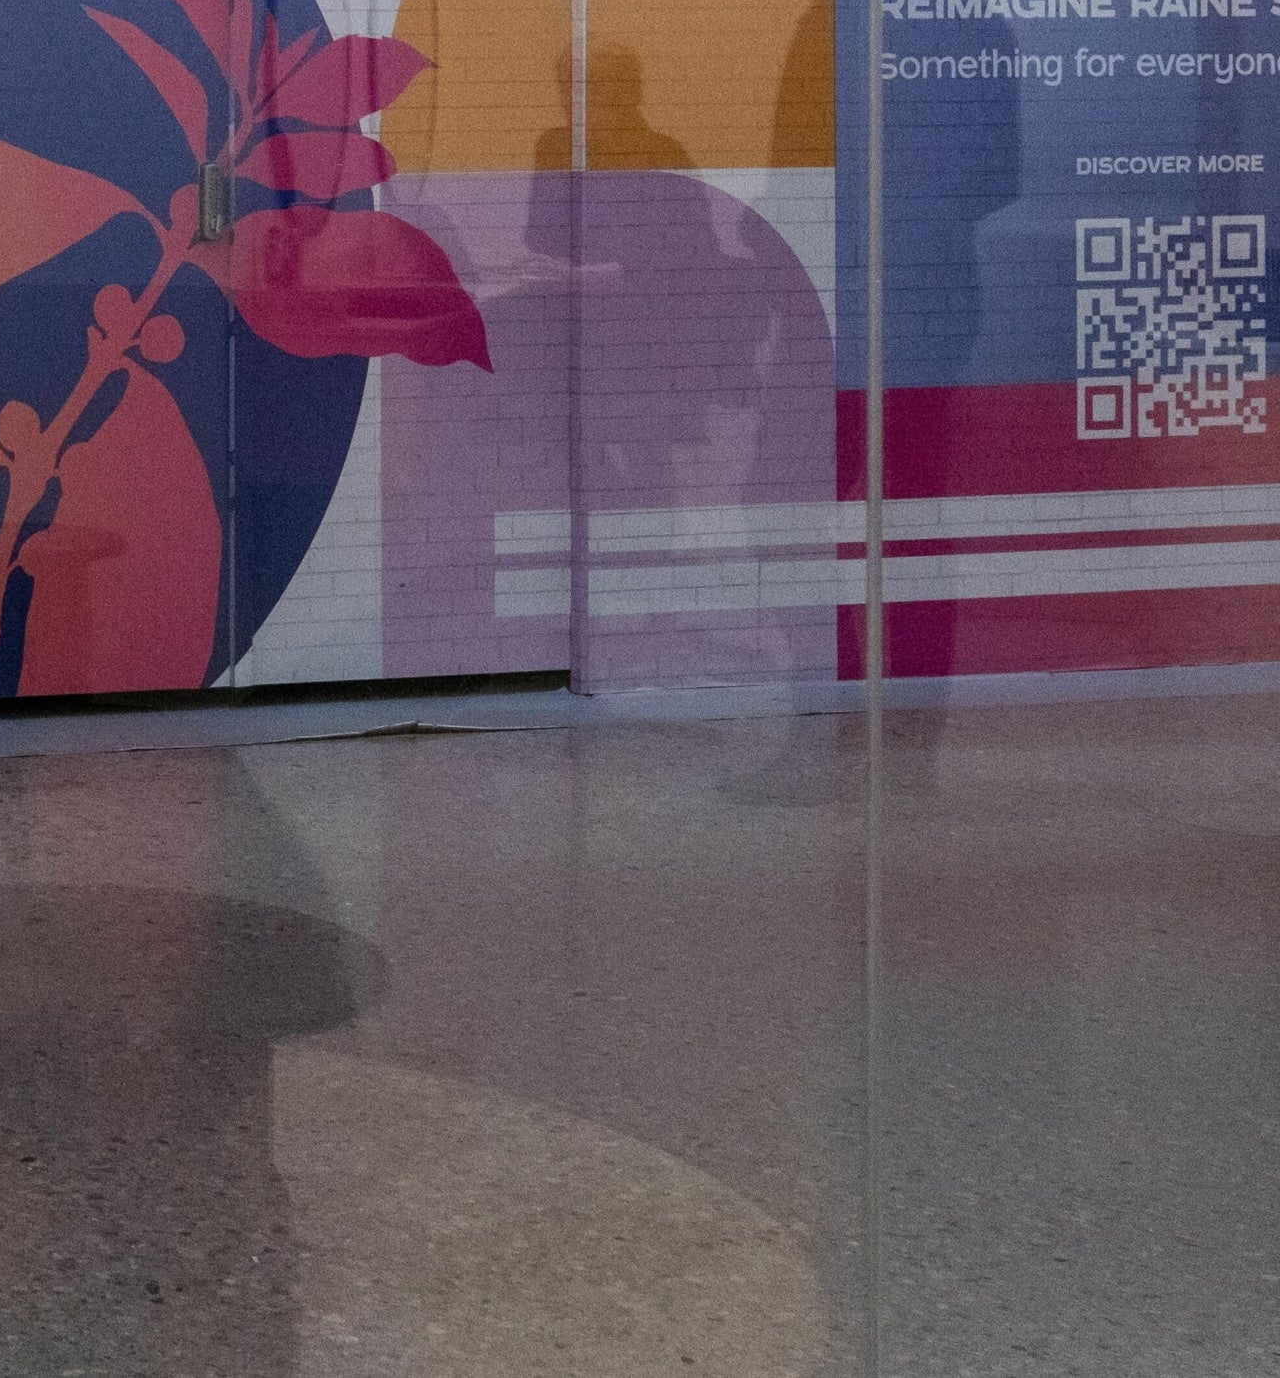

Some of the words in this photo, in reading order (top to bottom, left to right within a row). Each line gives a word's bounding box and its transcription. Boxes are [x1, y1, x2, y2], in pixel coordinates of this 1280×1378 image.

[881, 48, 1063, 87] Something
[1074, 47, 1125, 77] for
[1136, 51, 1280, 85] everyon
[1076, 154, 1192, 176] DISCOVER
[1198, 153, 1265, 174] MORE
